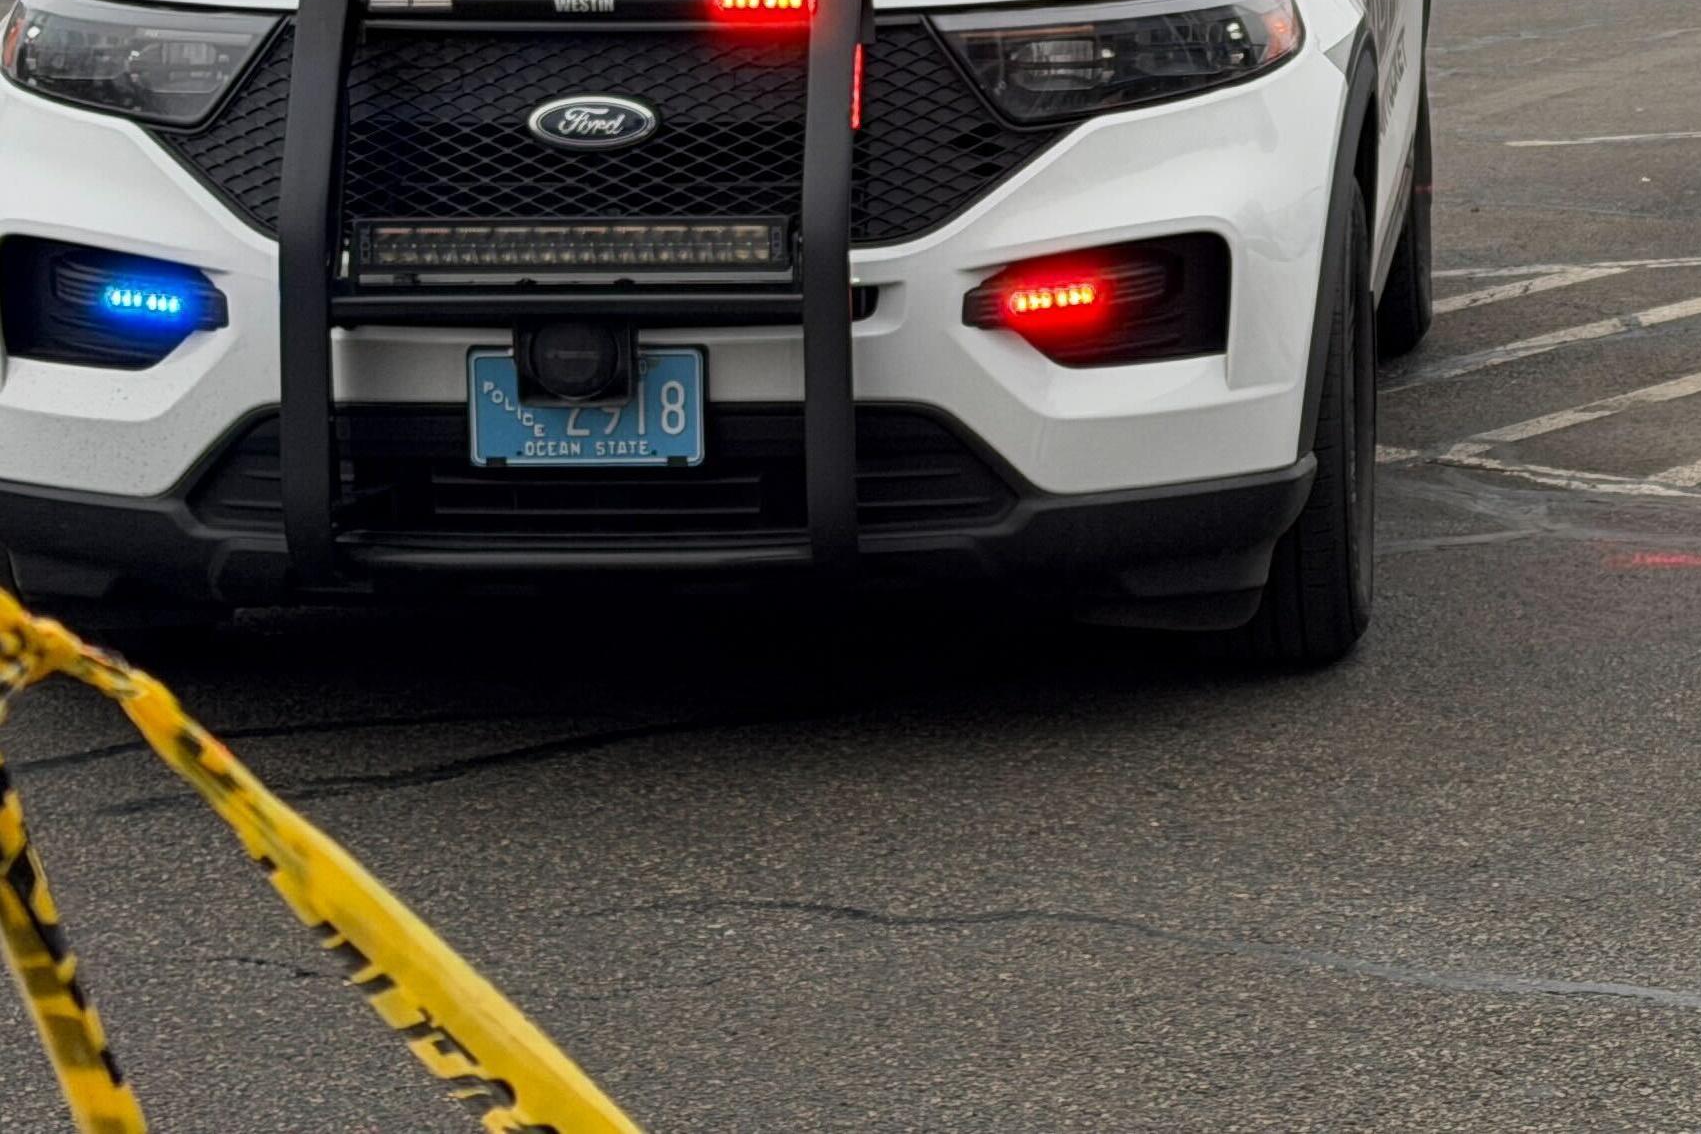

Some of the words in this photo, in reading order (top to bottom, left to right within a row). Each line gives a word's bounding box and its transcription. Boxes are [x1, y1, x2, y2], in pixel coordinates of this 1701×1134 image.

[558, 107, 626, 135] Ford
[483, 380, 546, 437] POLICE
[524, 440, 581, 456] OCEAN
[595, 440, 650, 456] STATE
